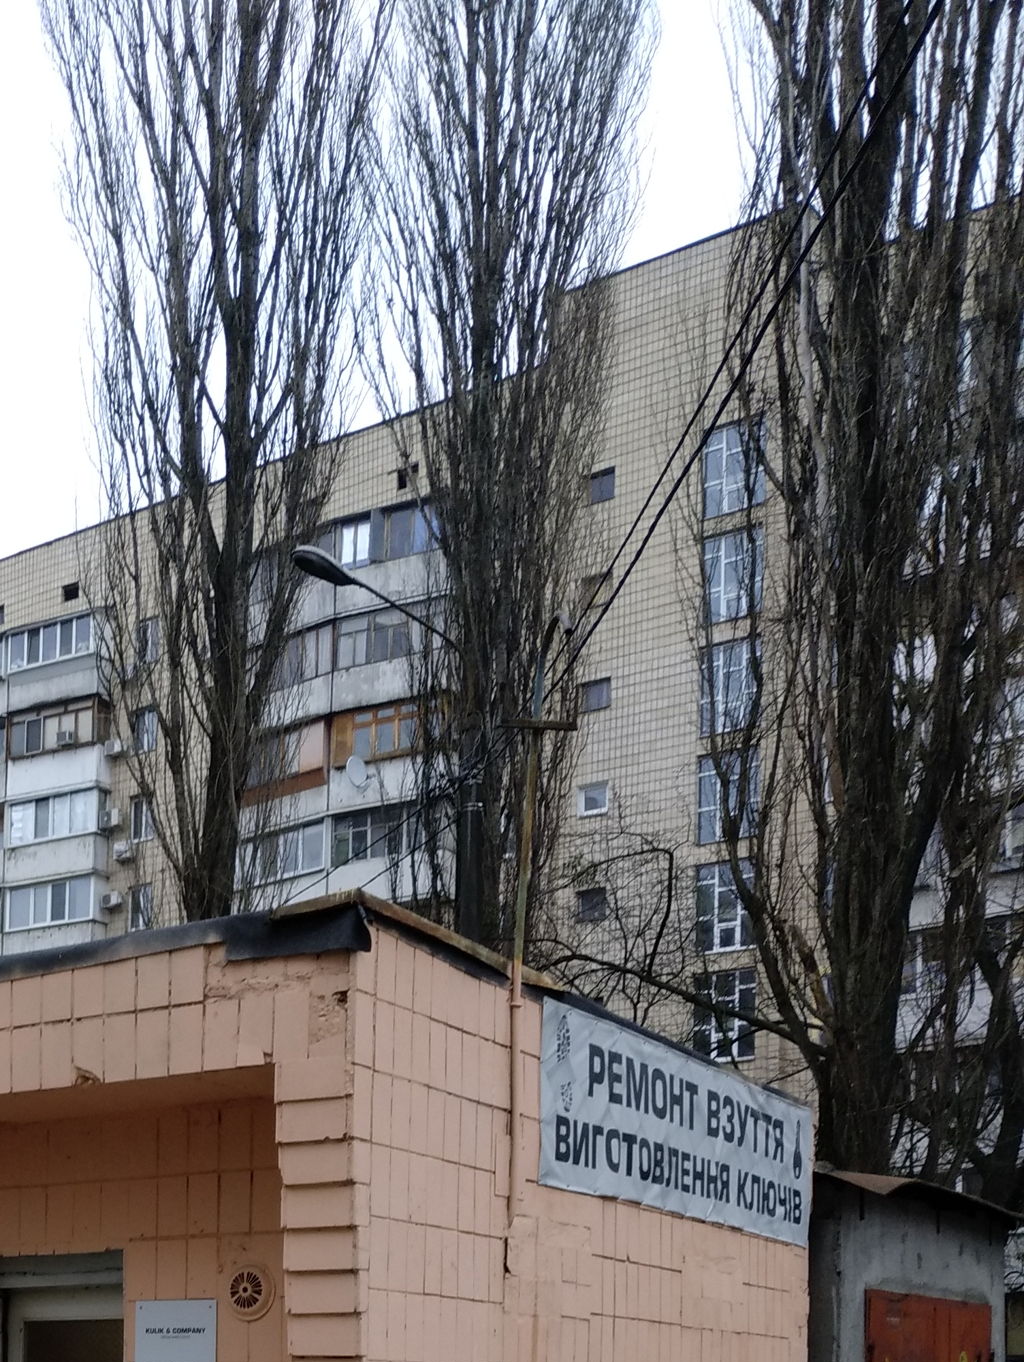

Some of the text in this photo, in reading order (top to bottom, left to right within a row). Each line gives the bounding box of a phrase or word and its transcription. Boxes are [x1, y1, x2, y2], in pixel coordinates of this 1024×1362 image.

[587, 1043, 784, 1164] РЕМОНТ ВЗУТТЯ
[554, 1115, 802, 1225] ВИГОТОВЛЕННЯ КЛЮЧІВ
